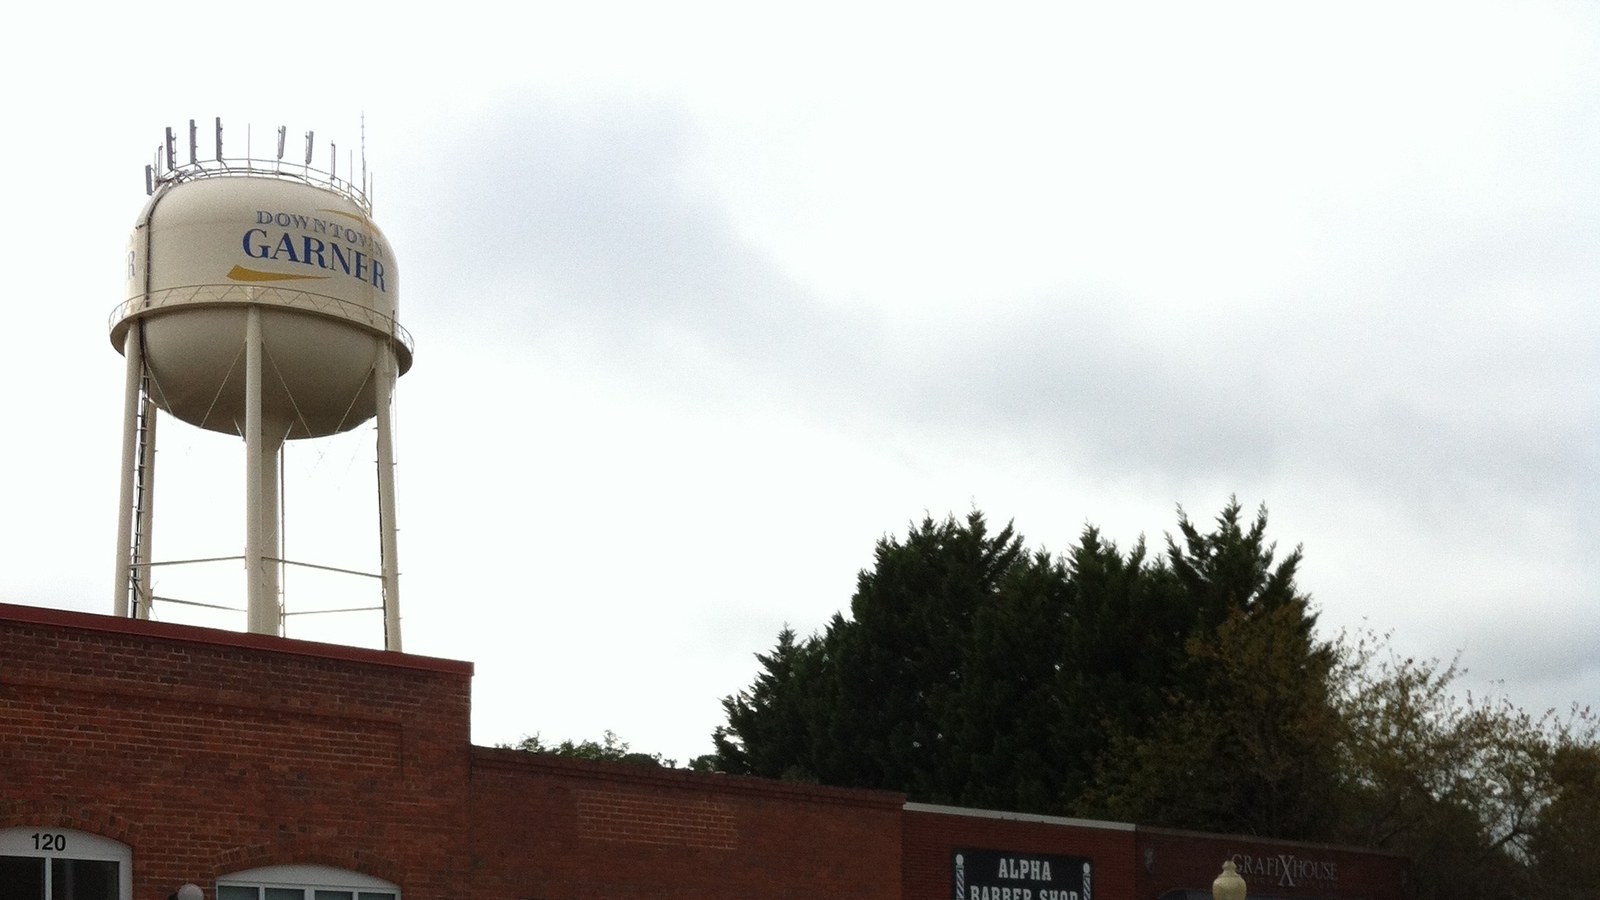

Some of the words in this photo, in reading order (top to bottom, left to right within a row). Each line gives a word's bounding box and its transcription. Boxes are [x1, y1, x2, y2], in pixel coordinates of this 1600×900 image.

[256, 210, 383, 258] DOWNTOWN
[242, 228, 386, 293] GARNER
[32, 833, 66, 851] 120
[998, 858, 1052, 882] ALPHA
[970, 885, 1031, 900] BARBER
